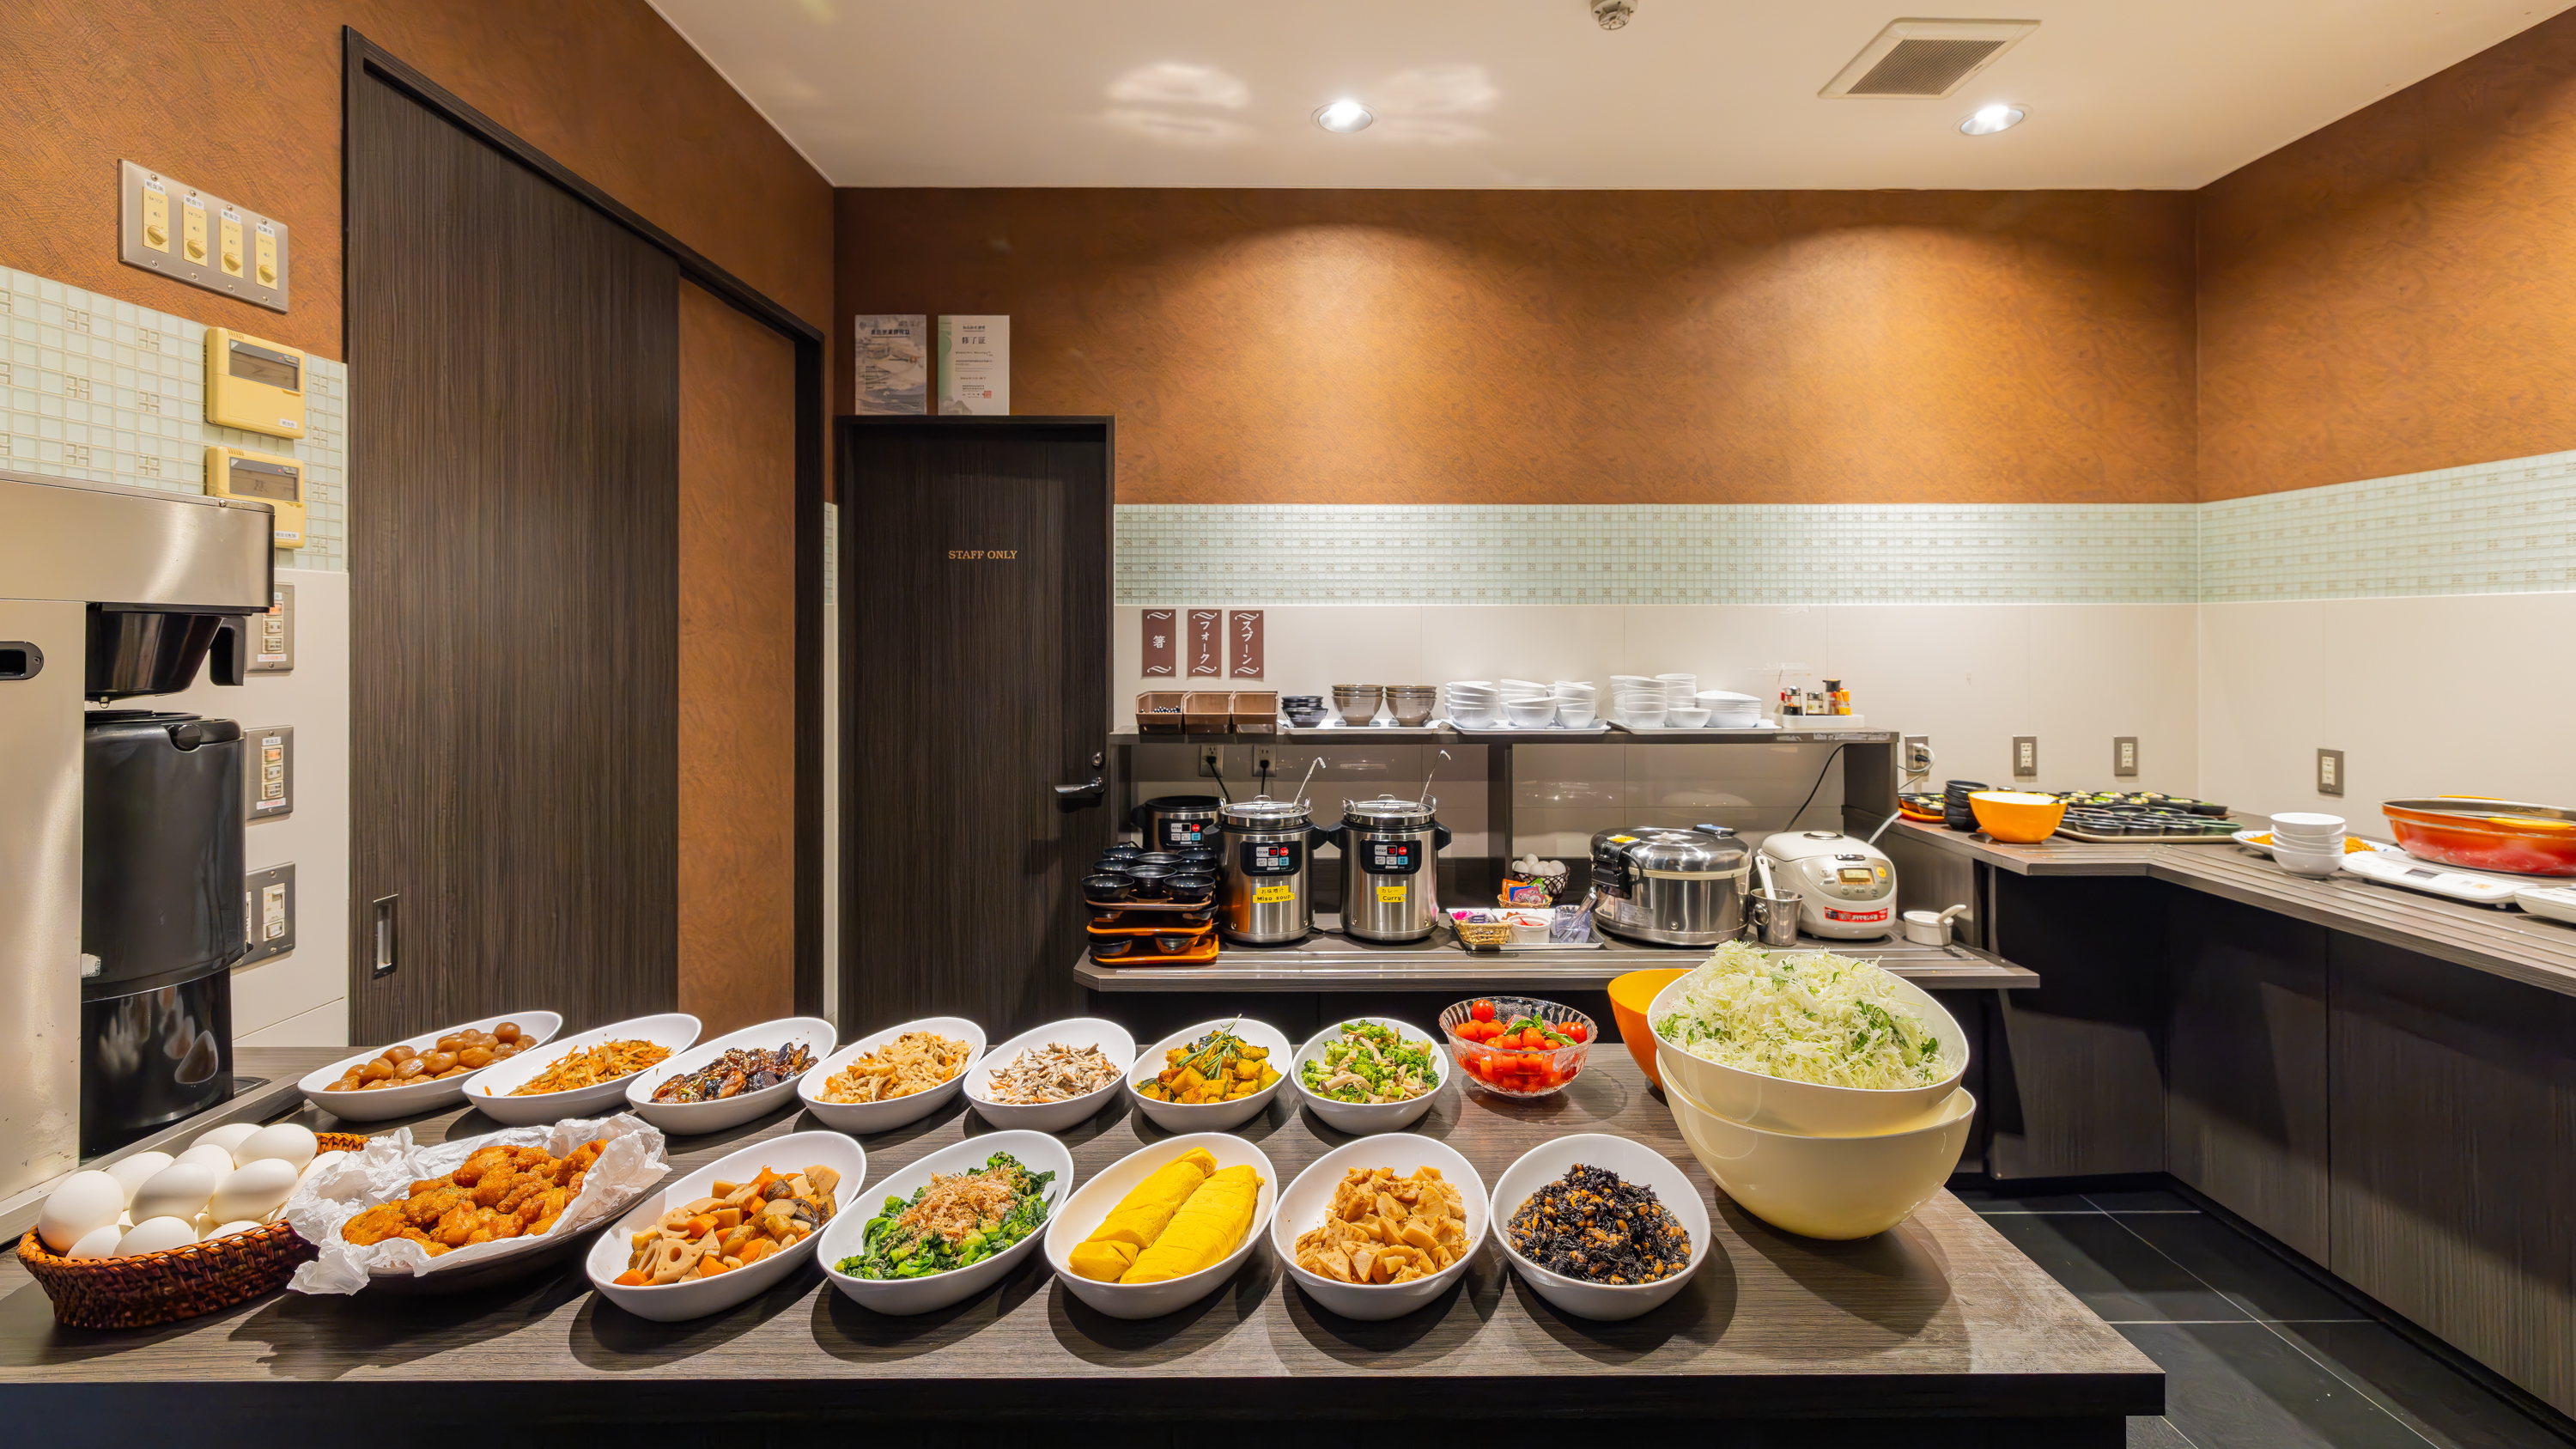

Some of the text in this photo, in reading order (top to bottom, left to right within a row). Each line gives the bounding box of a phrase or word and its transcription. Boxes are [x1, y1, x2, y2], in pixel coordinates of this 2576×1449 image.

[948, 550, 1018, 560] STAFF ONLY
[1153, 635, 1166, 648] 箸
[1200, 621, 1211, 665] フォーク
[1241, 620, 1254, 665] スプーン
